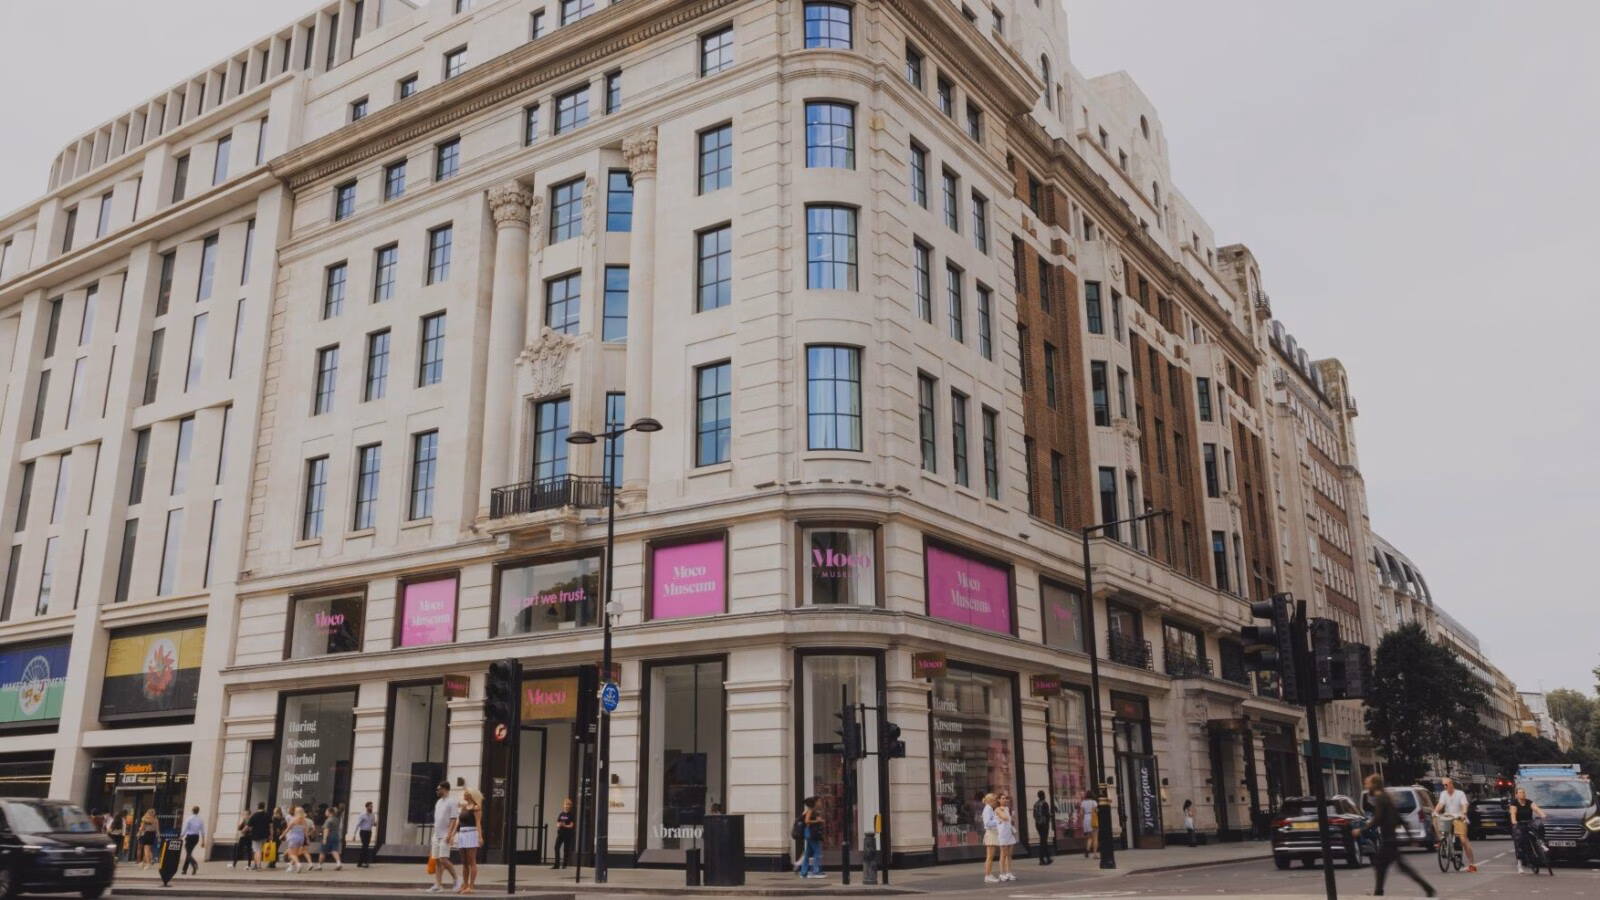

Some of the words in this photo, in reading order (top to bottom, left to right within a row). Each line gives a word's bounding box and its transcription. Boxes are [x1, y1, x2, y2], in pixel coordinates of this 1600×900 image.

[810, 548, 872, 568] Moco
[672, 565, 707, 579] Moco
[663, 580, 717, 597] Museum
[956, 570, 981, 592] Moco
[523, 594, 540, 607] art
[541, 592, 558, 604] we
[560, 586, 587, 602] trust.
[950, 589, 992, 613] Museum
[918, 660, 943, 669] Moco
[1036, 681, 1058, 689] Moco
[526, 688, 567, 705] Moco
[288, 720, 317, 733] Haring
[286, 753, 316, 765] Warhol
[284, 770, 320, 785] Basquiat
[282, 787, 303, 799] Hirst
